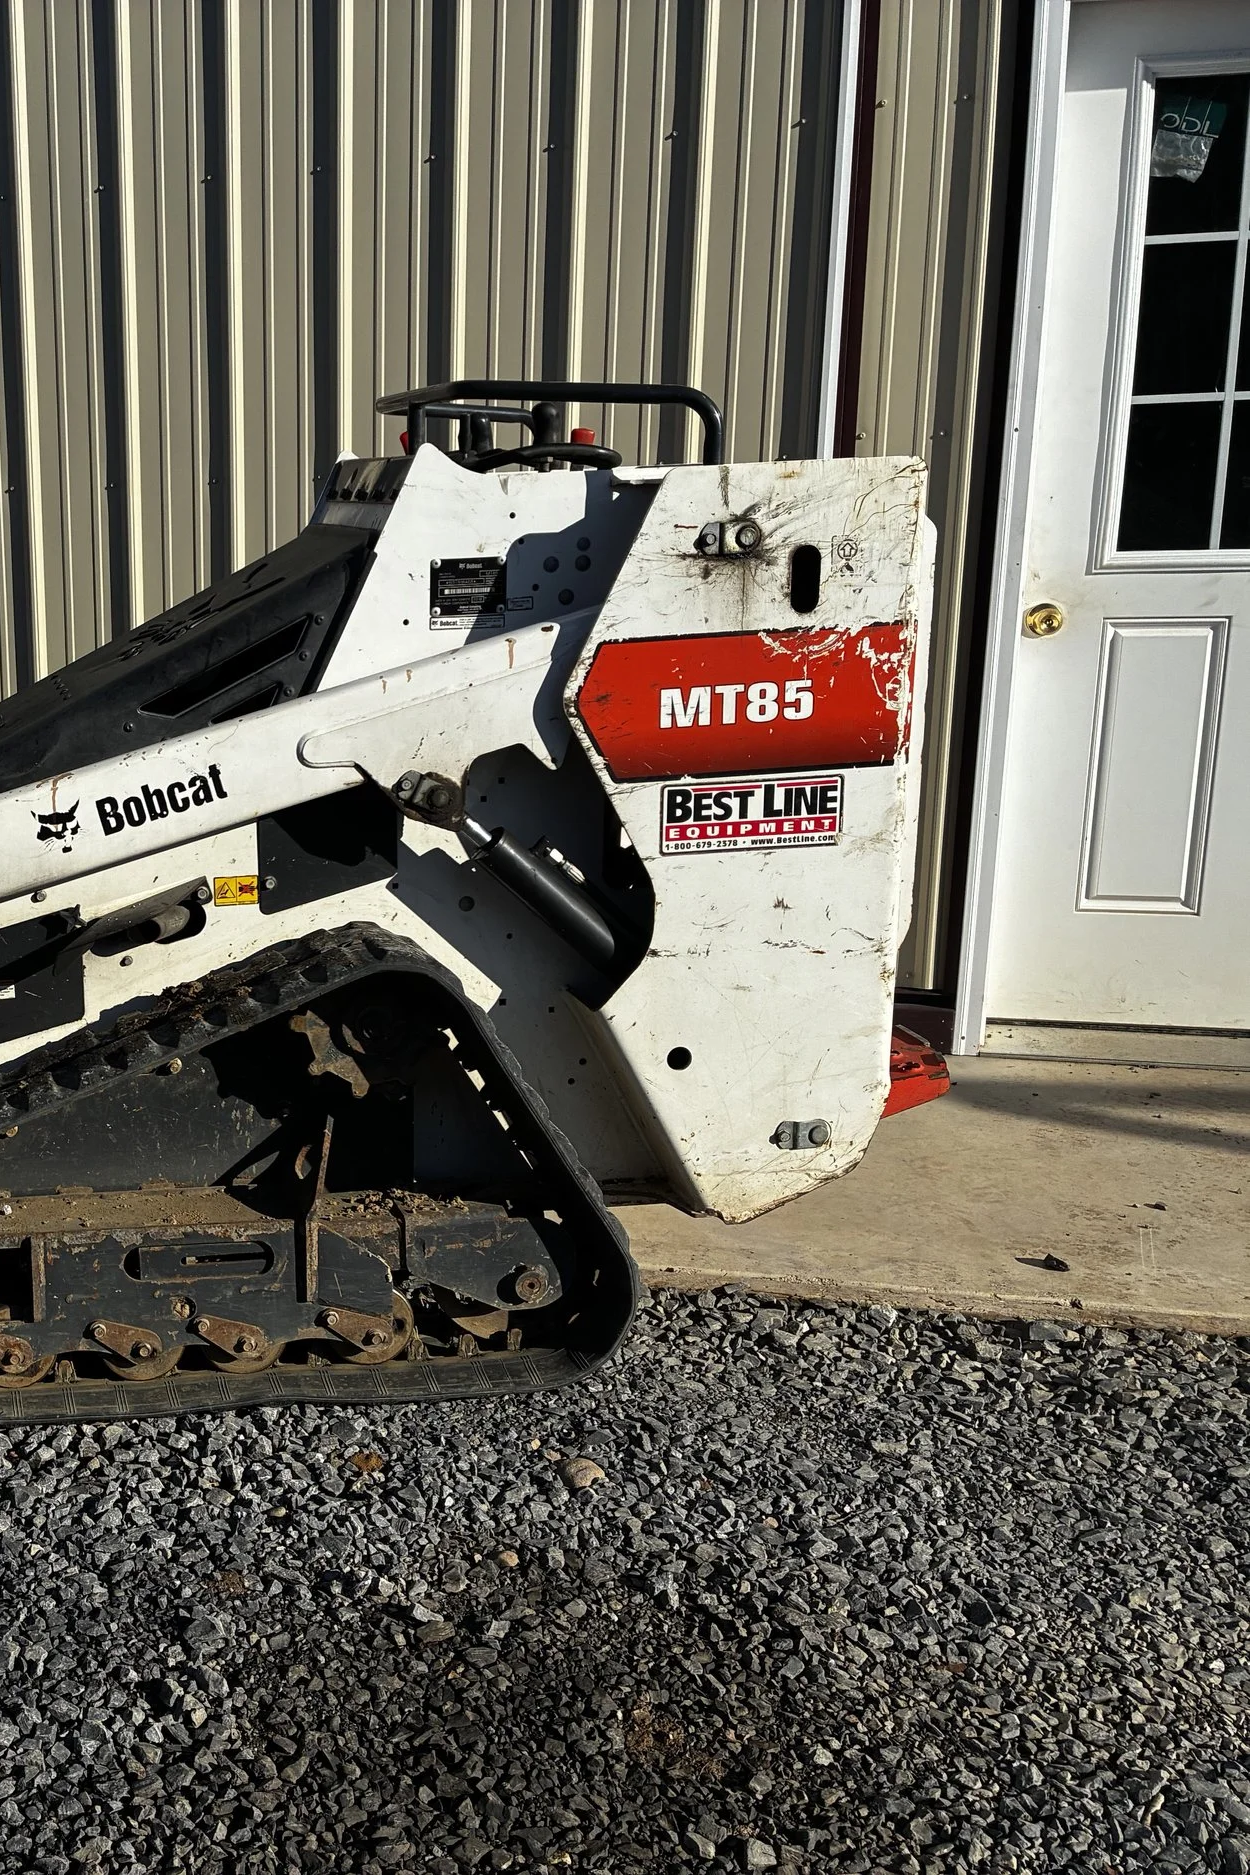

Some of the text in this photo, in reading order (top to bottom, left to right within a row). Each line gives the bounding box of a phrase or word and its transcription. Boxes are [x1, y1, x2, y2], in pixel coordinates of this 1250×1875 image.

[659, 679, 814, 729] MT85
[95, 763, 229, 837] Bobcat
[666, 783, 838, 824] BEST LINE
[668, 818, 834, 839] EQUIPMENT
